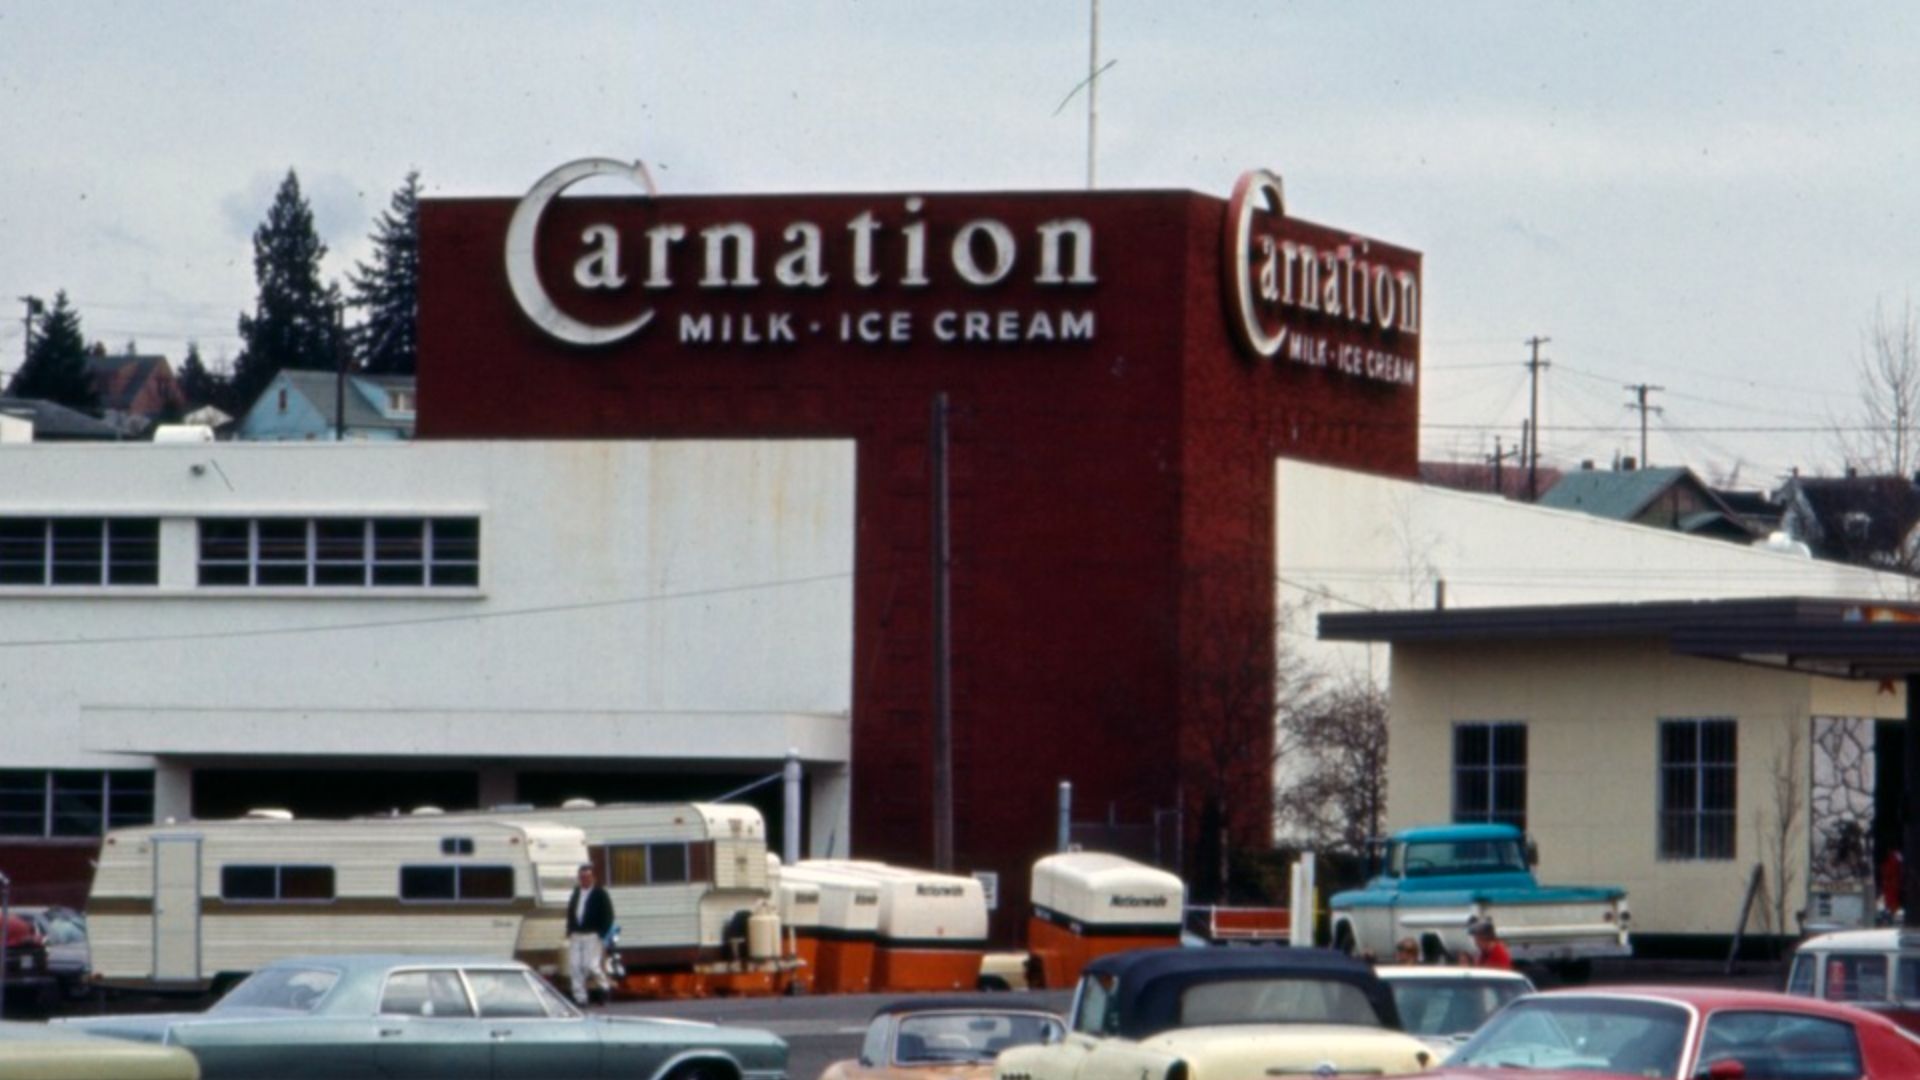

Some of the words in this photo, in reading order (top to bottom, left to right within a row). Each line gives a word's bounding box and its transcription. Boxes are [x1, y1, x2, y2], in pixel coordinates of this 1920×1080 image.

[505, 157, 1096, 345] Carnation
[1228, 169, 1419, 356] Carnation
[680, 314, 796, 342] MILK
[841, 312, 911, 341] ICE
[934, 311, 1095, 340] CREAM
[1289, 334, 1327, 365] MILK
[1338, 344, 1362, 374] ICE
[1366, 350, 1415, 385] CREAM
